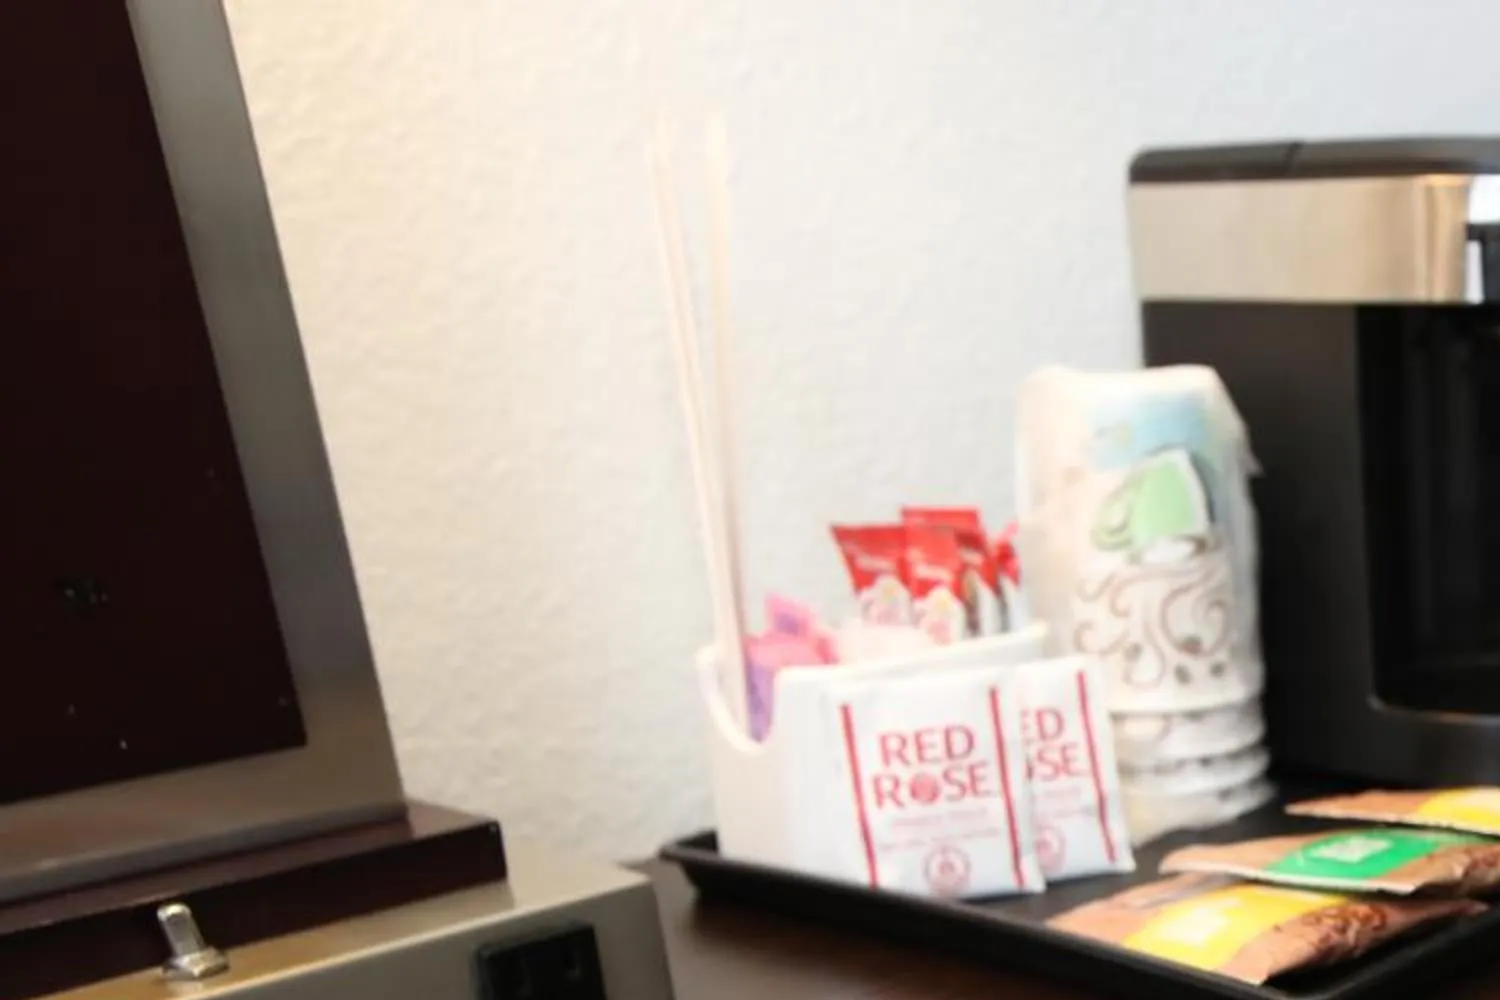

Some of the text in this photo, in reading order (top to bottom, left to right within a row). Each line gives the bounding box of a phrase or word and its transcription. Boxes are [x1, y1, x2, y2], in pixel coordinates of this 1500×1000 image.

[878, 724, 975, 767] RED
[1021, 708, 1065, 744] ED
[1027, 741, 1087, 782] SE
[871, 760, 993, 809] ROSE
